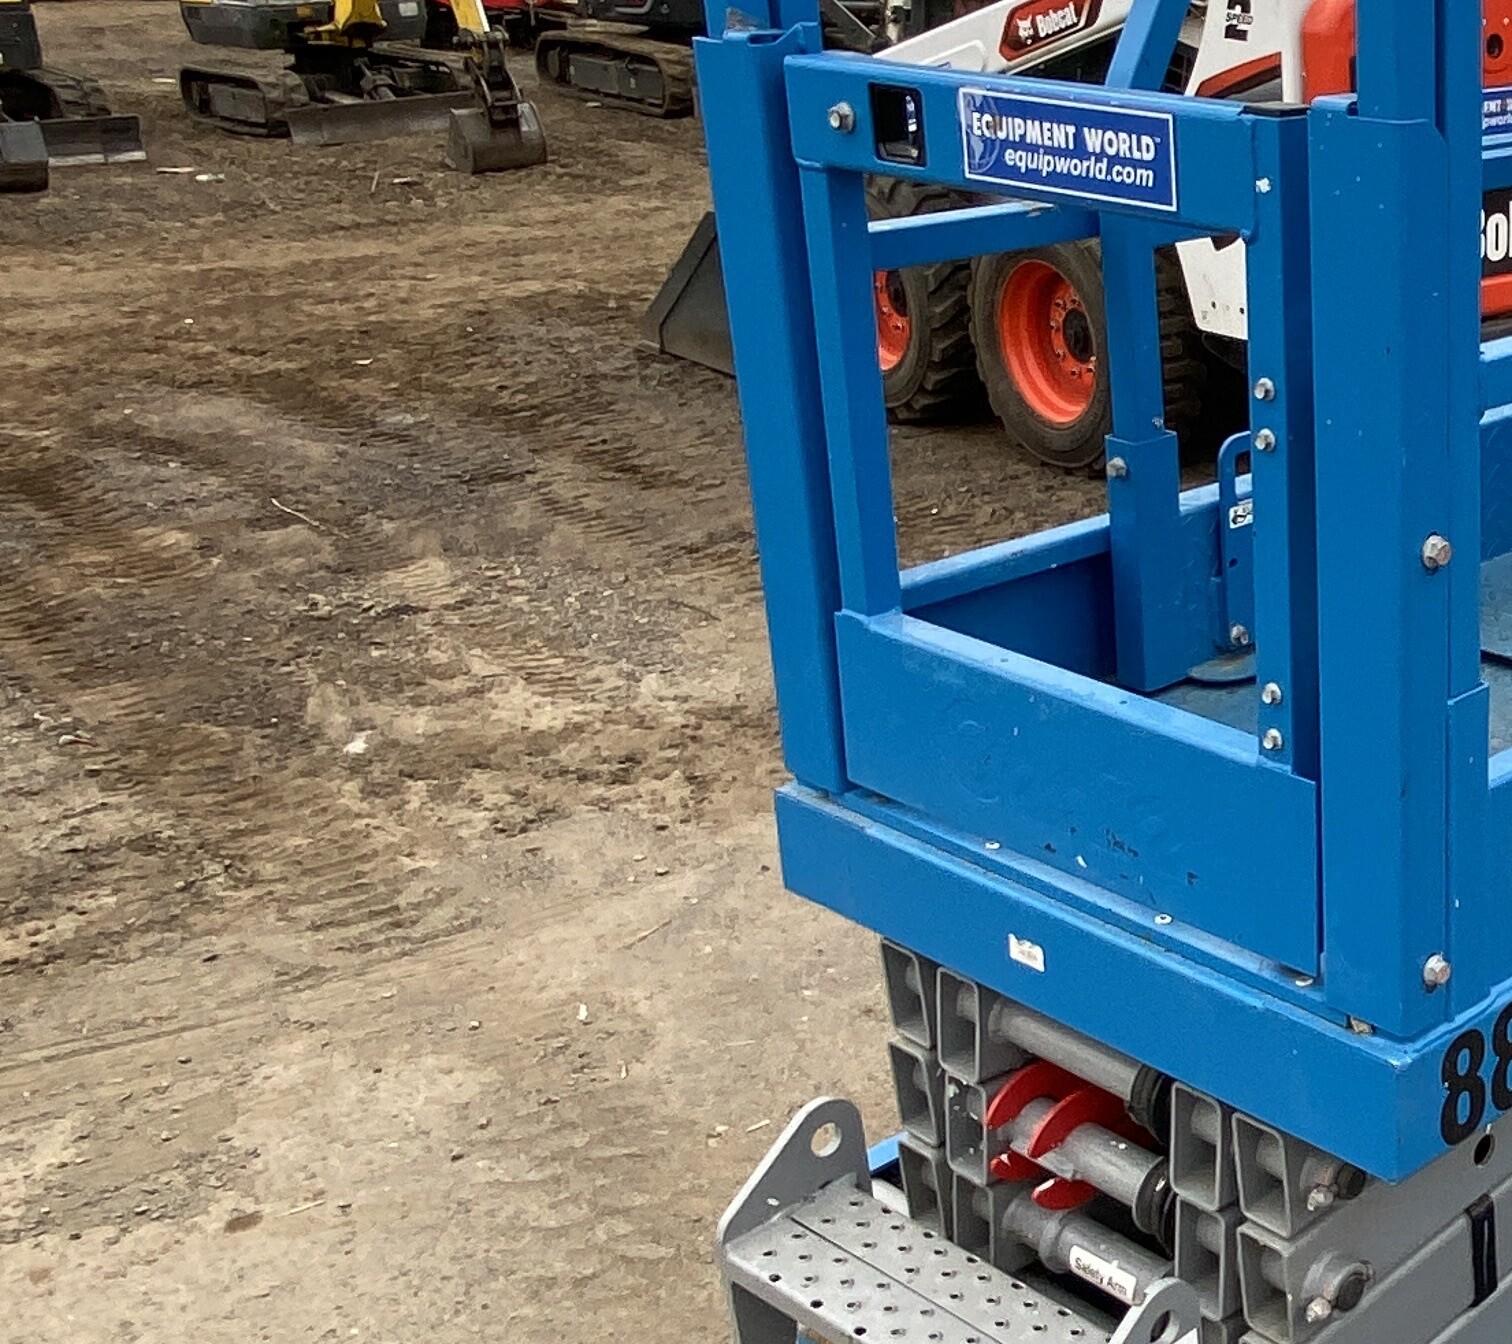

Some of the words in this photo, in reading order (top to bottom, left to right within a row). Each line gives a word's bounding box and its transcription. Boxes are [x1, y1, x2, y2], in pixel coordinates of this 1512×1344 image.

[1035, 1, 1078, 39] Bobcat
[972, 111, 1076, 151] EQUIPMENT
[1084, 126, 1155, 161] WORLD
[1004, 148, 1154, 187] equipworld.com
